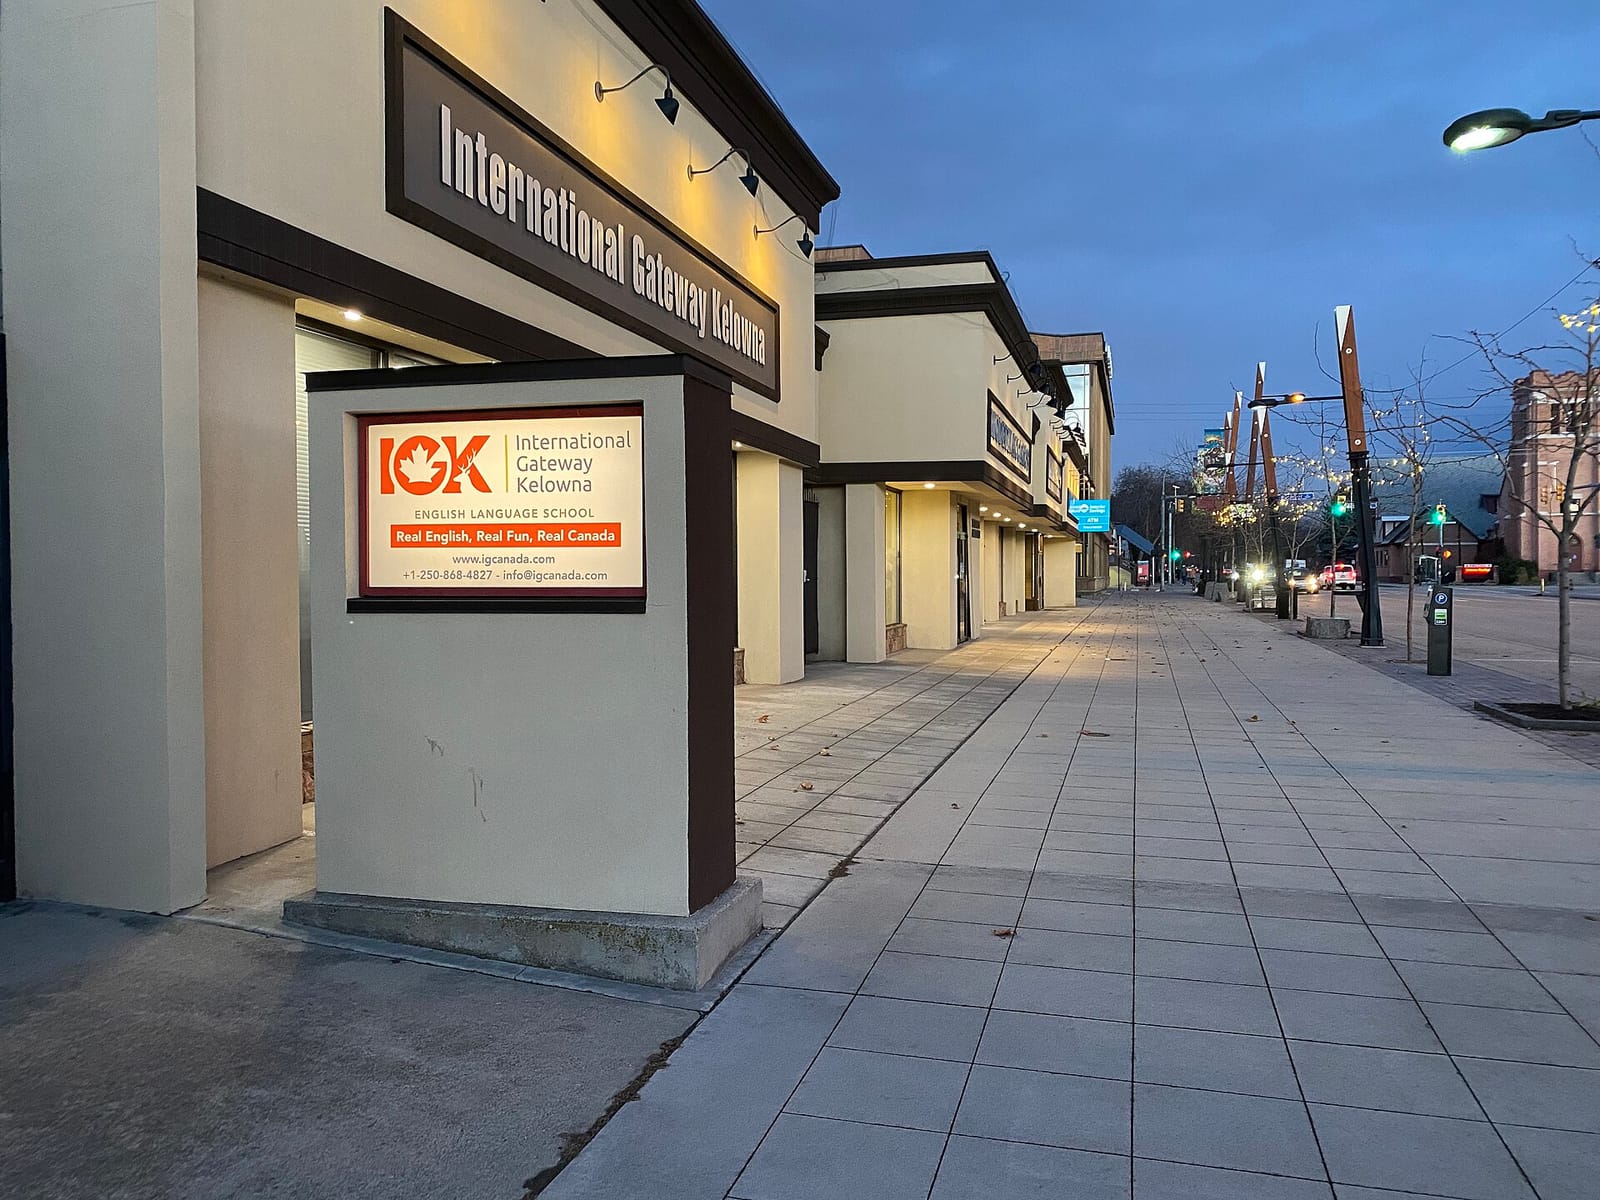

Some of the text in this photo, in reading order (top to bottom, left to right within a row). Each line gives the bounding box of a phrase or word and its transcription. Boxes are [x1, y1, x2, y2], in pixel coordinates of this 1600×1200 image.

[439, 103, 766, 366] International Gateway Kelowna
[516, 430, 632, 450] International
[516, 455, 593, 474] Gateway
[516, 476, 592, 493] Kelowna
[415, 508, 594, 519] ENGLISH LANGUAGE SCHOOL
[396, 529, 615, 545] Real English, Real Fun, Real Canada
[452, 554, 555, 567] www.igcanada.com
[403, 569, 492, 581] +1-250-868-4827
[503, 569, 608, 582] info@igcanada.com
